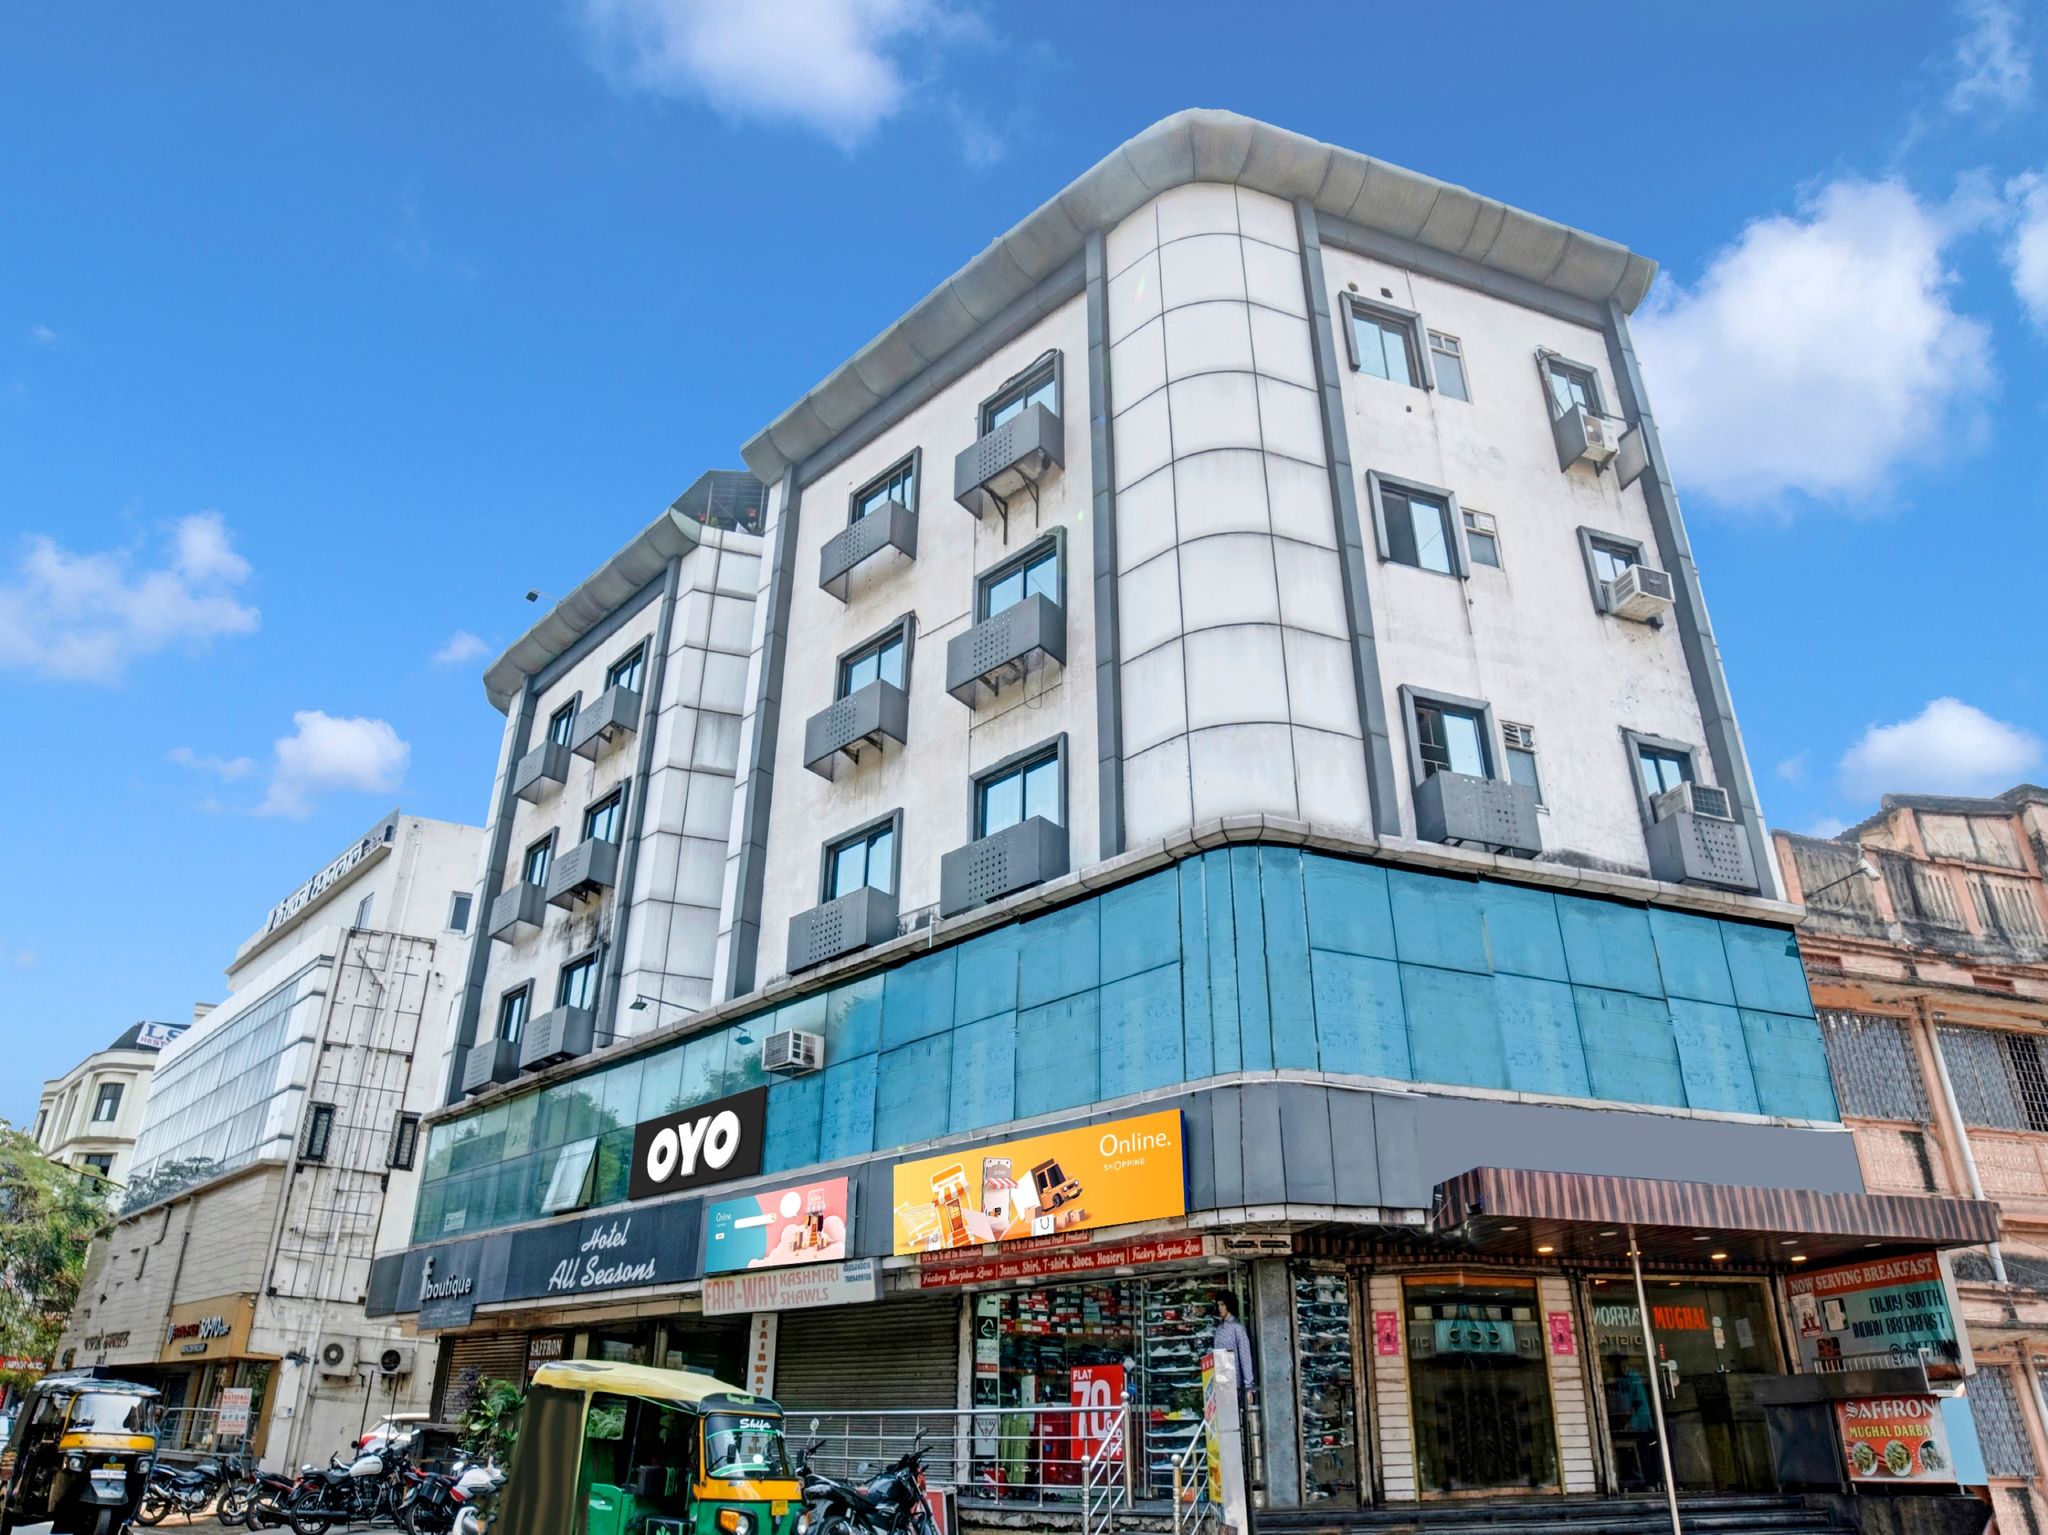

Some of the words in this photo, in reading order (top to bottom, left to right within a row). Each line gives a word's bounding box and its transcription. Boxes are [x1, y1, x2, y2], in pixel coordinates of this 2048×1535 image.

[647, 1110, 741, 1183] OYO
[1103, 1158, 1145, 1171] SHOPPING
[581, 1217, 631, 1252] Hotel
[547, 1257, 581, 1291] All
[581, 1255, 656, 1287] Seasons
[922, 1271, 947, 1284] Factory
[949, 1268, 975, 1282] Surplus
[976, 1266, 993, 1279] Zone
[1097, 1250, 1125, 1265] Hosiery
[1132, 1246, 1155, 1262] Factory
[1157, 1243, 1182, 1260] Surplus
[1184, 1239, 1200, 1255] Zone
[426, 1275, 472, 1300] boutique
[780, 1267, 839, 1287] KASHMIRI
[1790, 1278, 1814, 1295] NOW
[1815, 1269, 1862, 1291] SERVING
[1864, 1257, 1934, 1283] BREAKFAST
[781, 1287, 830, 1305] SHAWLS
[1869, 1295, 1903, 1314] ENJOY
[1905, 1288, 1943, 1309] SOUTH
[1652, 1306, 1709, 1329] MUGHAL
[1852, 1319, 1884, 1338] INDIAN
[1886, 1312, 1946, 1335] BREAKFAST
[530, 1339, 562, 1356] SAFFRON
[754, 1319, 769, 1395] FAIRWAY
[1073, 1369, 1092, 1380] FLAT
[1844, 1399, 1938, 1420] SAFFRON
[740, 1418, 772, 1430] Shifa
[1849, 1425, 1892, 1438] MUGHAL
